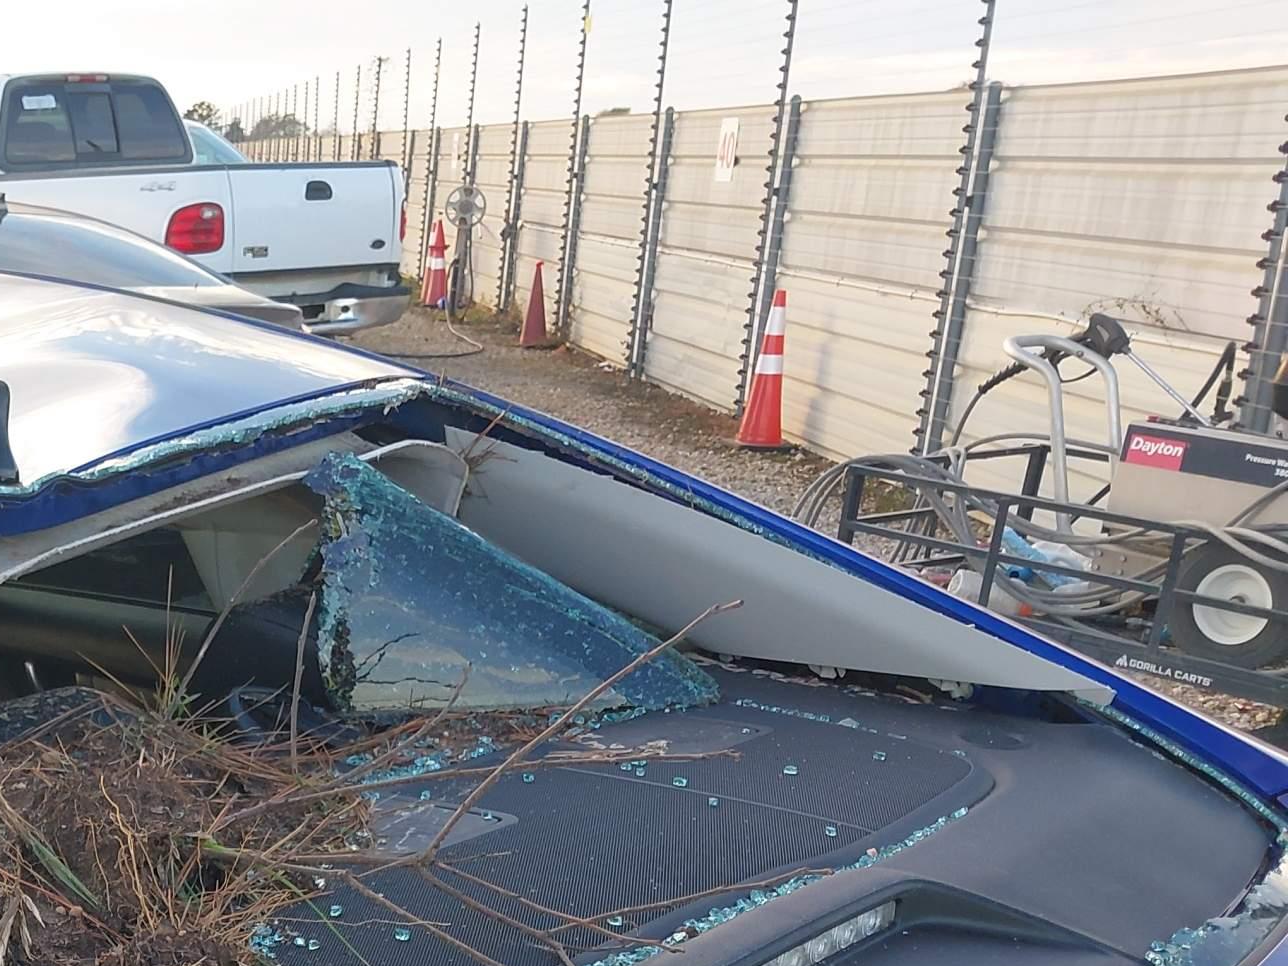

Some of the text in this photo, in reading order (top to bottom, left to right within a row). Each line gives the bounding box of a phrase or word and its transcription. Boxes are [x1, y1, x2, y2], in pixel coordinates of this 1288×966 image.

[719, 131, 735, 168] 40
[1130, 437, 1184, 457] Dayton
[1245, 453, 1276, 466] Pressure
[1129, 659, 1211, 686] GORILLA CARTS
